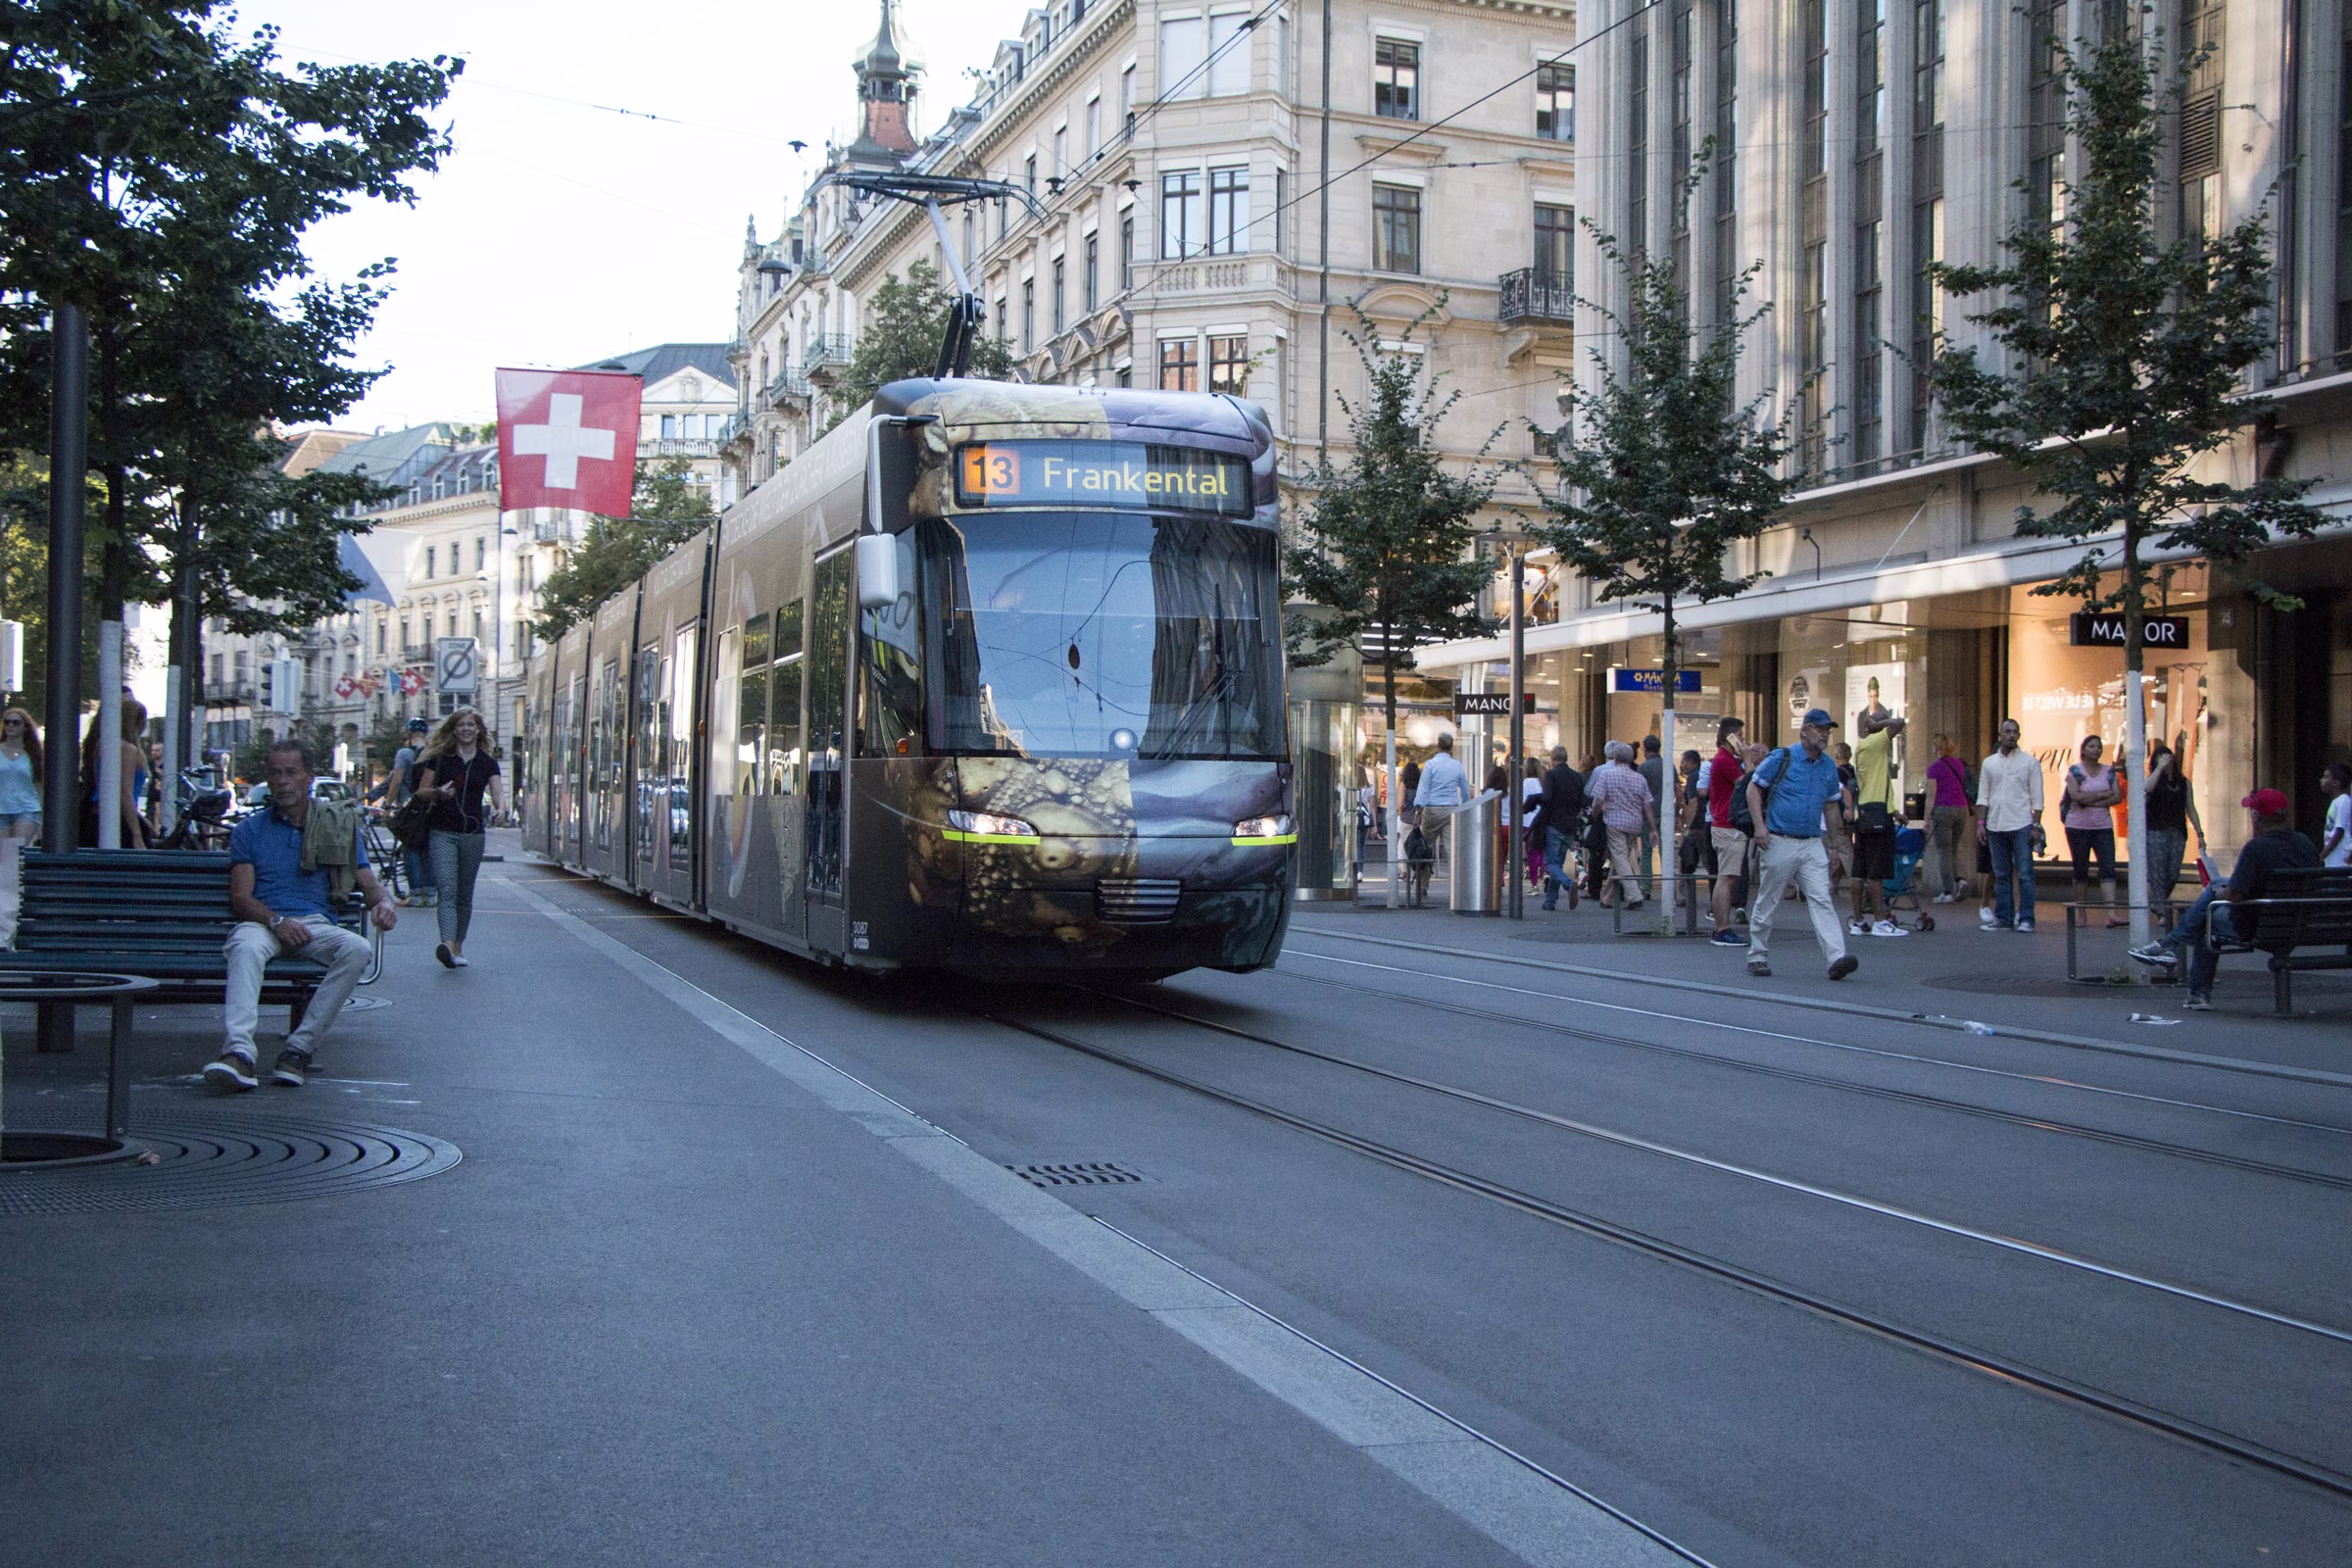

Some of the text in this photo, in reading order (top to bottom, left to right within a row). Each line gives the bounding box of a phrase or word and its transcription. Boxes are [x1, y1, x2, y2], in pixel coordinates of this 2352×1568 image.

[971, 455, 1228, 495] 13 Frankental
[2091, 619, 2176, 642] MAOR
[1643, 671, 1681, 685] MANA
[853, 921, 868, 935] 3087
